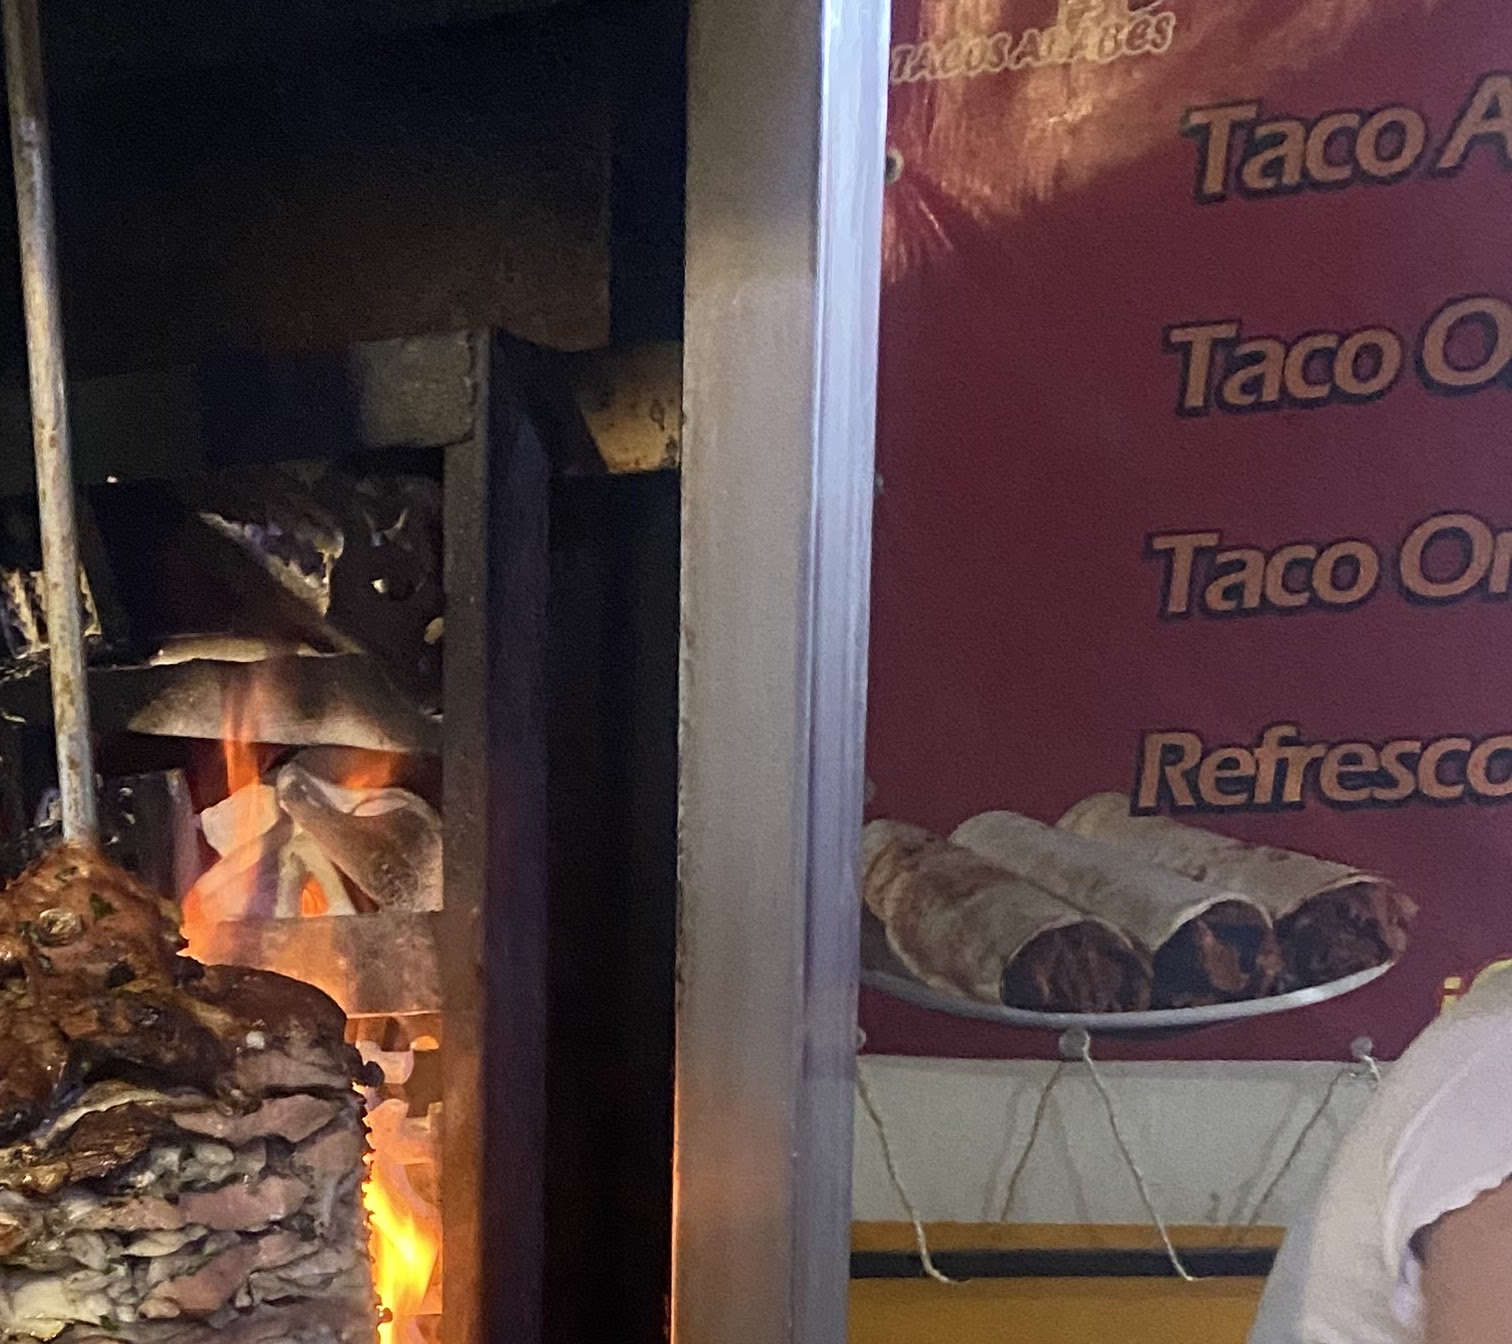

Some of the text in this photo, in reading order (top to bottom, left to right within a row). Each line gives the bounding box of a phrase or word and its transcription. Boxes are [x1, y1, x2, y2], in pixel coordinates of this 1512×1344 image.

[890, 31, 1011, 84] TACOS
[1187, 102, 1427, 197] Taco
[1168, 321, 1402, 409] Taco
[1150, 531, 1380, 614] Taco
[1136, 723, 1512, 809] Refresco
